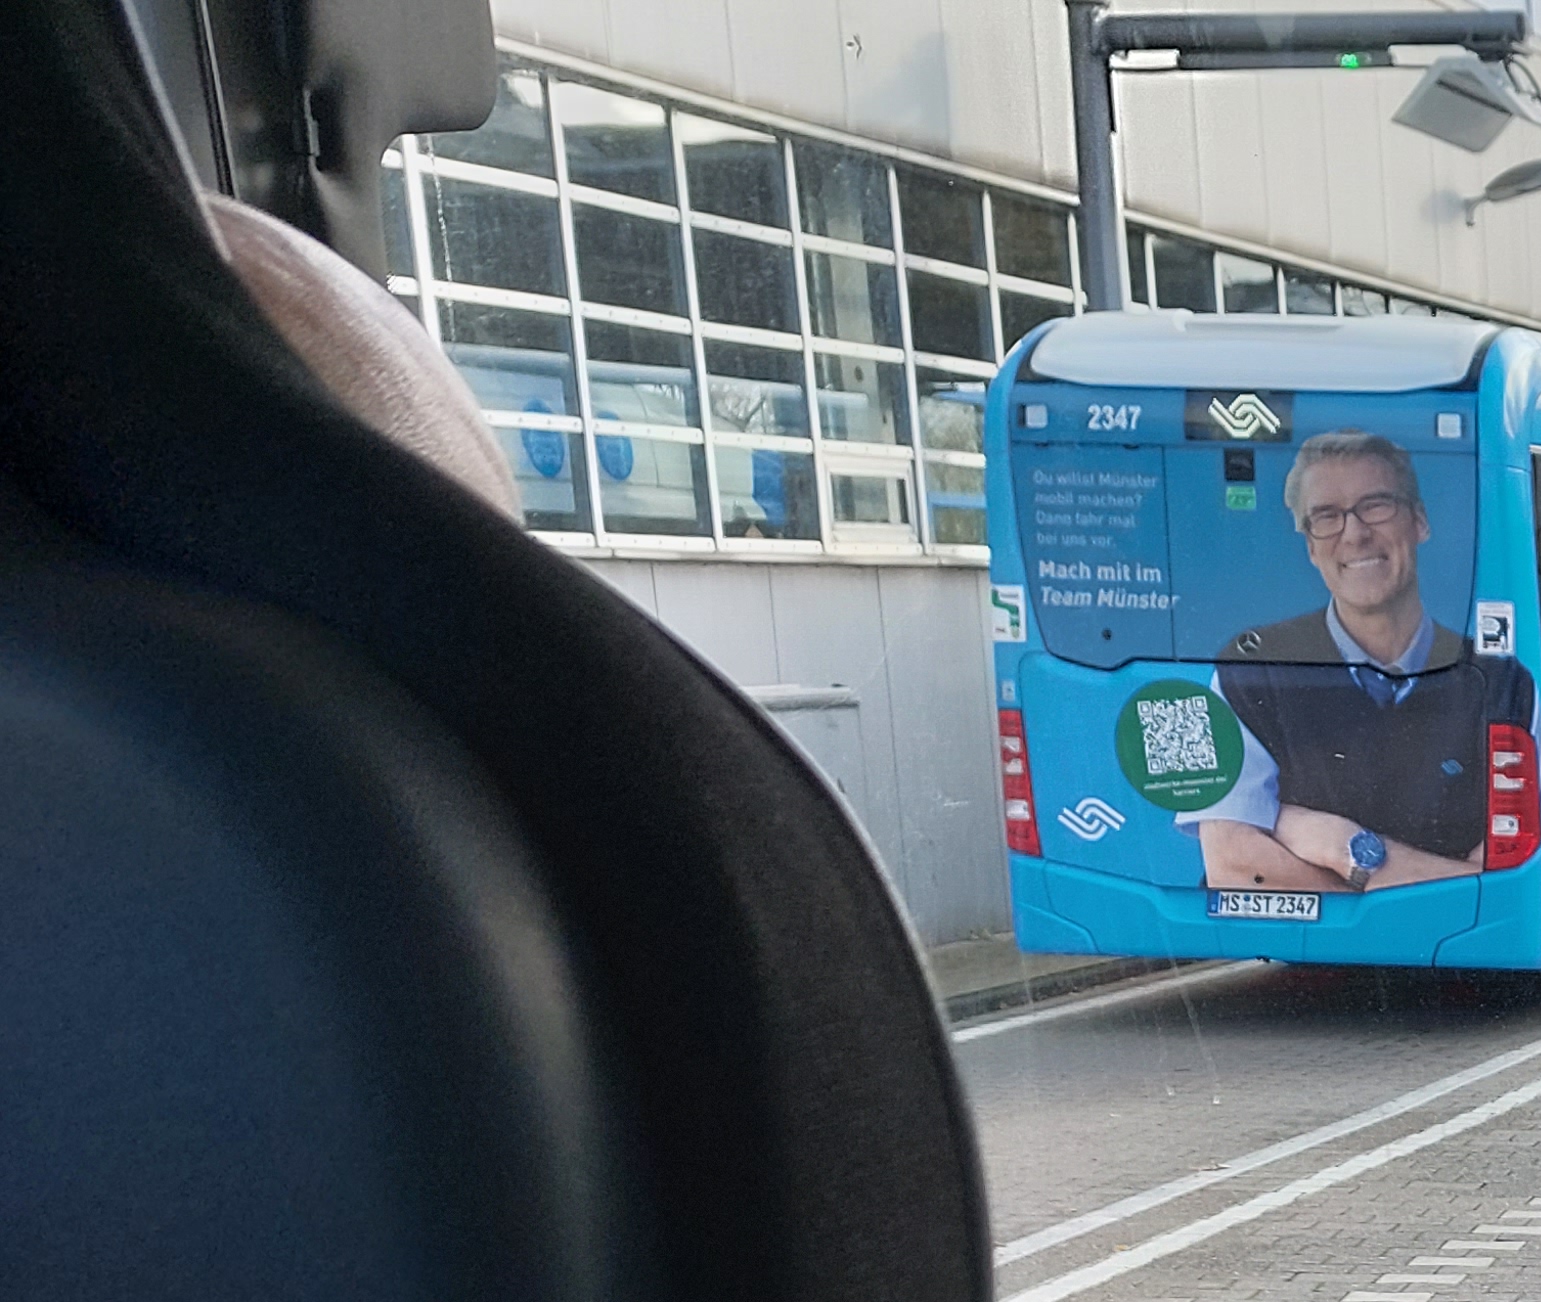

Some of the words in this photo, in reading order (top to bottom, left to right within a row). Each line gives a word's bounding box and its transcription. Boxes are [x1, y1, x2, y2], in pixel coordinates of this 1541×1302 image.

[1087, 403, 1142, 431] 2347
[1100, 472, 1158, 488] Münster
[1038, 559, 1092, 580] Mach
[1097, 561, 1131, 581] mit
[1136, 562, 1162, 583] im
[1041, 586, 1092, 606] Team
[1097, 587, 1181, 609] Münster
[1252, 895, 1272, 913] ST
[1277, 896, 1316, 915] 2347
